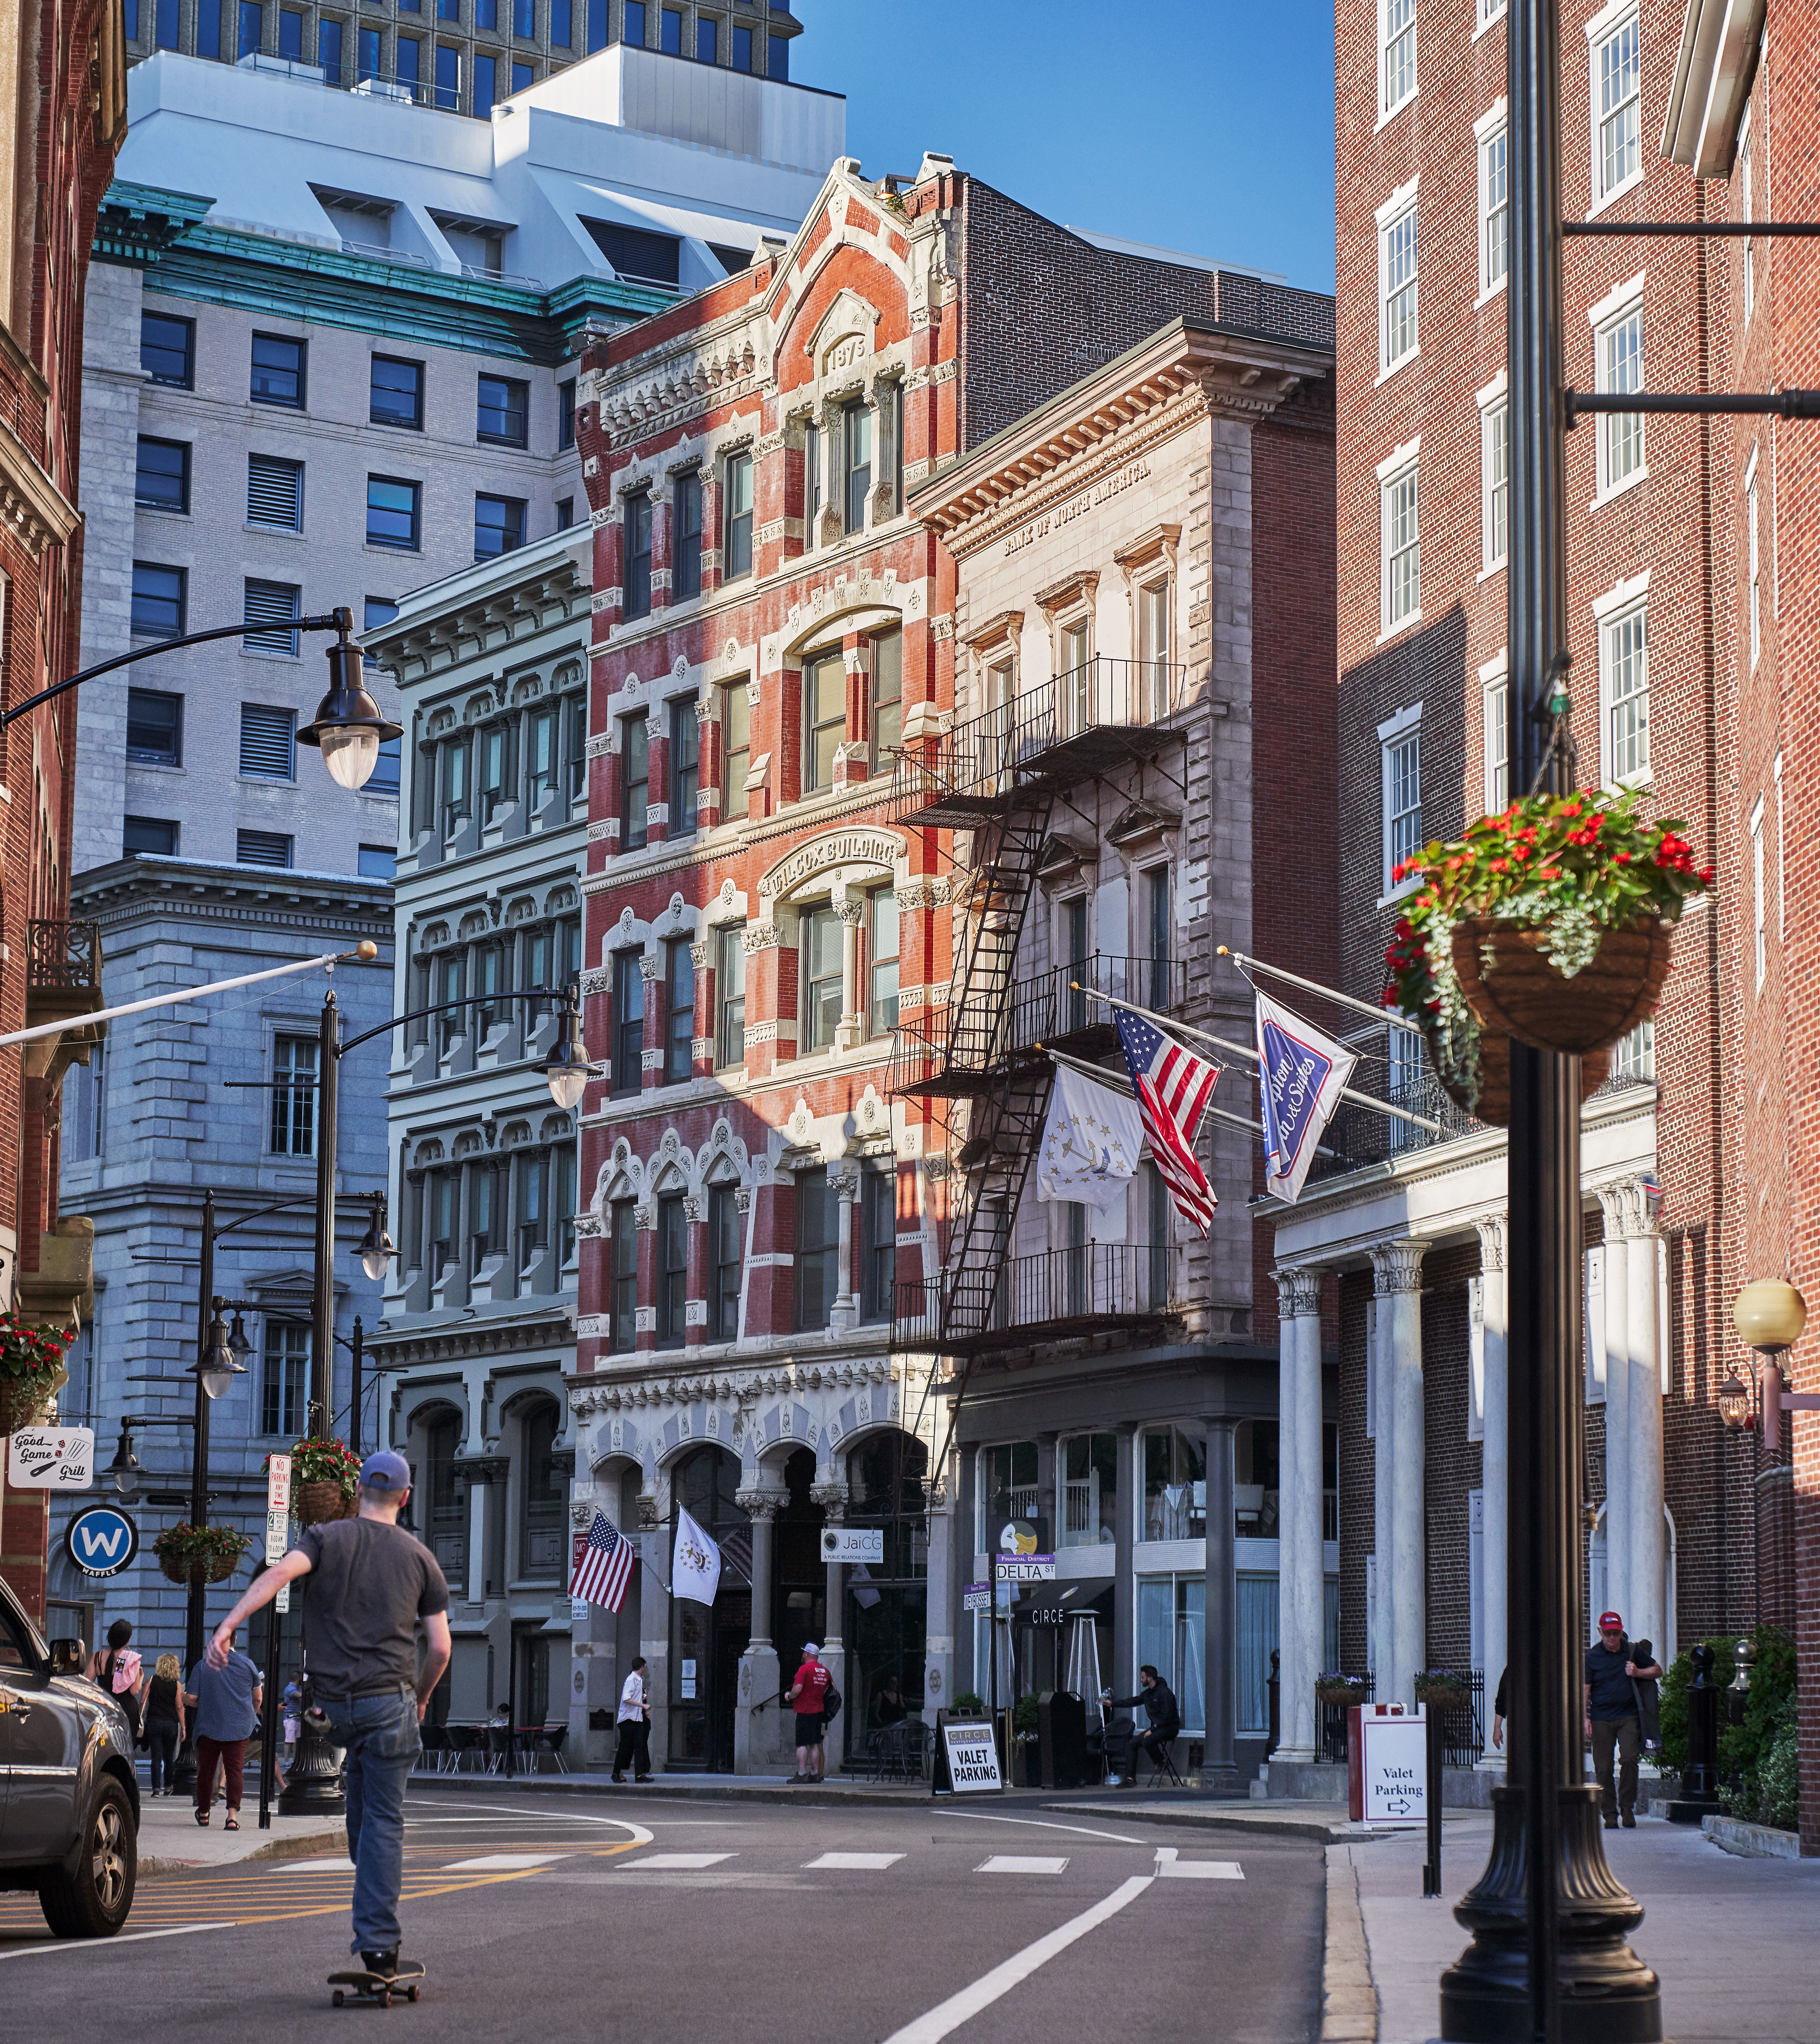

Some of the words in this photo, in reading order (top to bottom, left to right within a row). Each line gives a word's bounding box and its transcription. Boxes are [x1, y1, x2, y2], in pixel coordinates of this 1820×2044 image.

[831, 338, 865, 370] 1875
[1004, 526, 1033, 557] BANK
[1037, 516, 1050, 538] OF
[1053, 493, 1091, 529] NORTH
[772, 845, 825, 894] WILCOX
[827, 838, 894, 866] BUILDING
[1289, 1057, 1315, 1106] Suites
[1288, 1104, 1301, 1118] &
[15, 1434, 53, 1450] Good
[20, 1448, 53, 1464] Game
[59, 1465, 86, 1481] Grill
[276, 1461, 284, 1471] NO
[271, 1472, 288, 1483] PARKING
[269, 1513, 273, 1526] 2
[81, 1527, 123, 1557] W
[843, 1536, 881, 1550] JaiCG
[82, 1567, 117, 1577] WAFFLE
[997, 1565, 1042, 1578] DELTA
[964, 1593, 989, 1609] WEYBOSSET
[1033, 1609, 1063, 1624] CIRCE
[950, 1731, 989, 1739] CIRCE
[957, 1750, 987, 1765] VALET
[954, 1766, 997, 1782] PARKING
[1383, 1767, 1413, 1778] Valet
[1375, 1784, 1423, 1798] Parking
